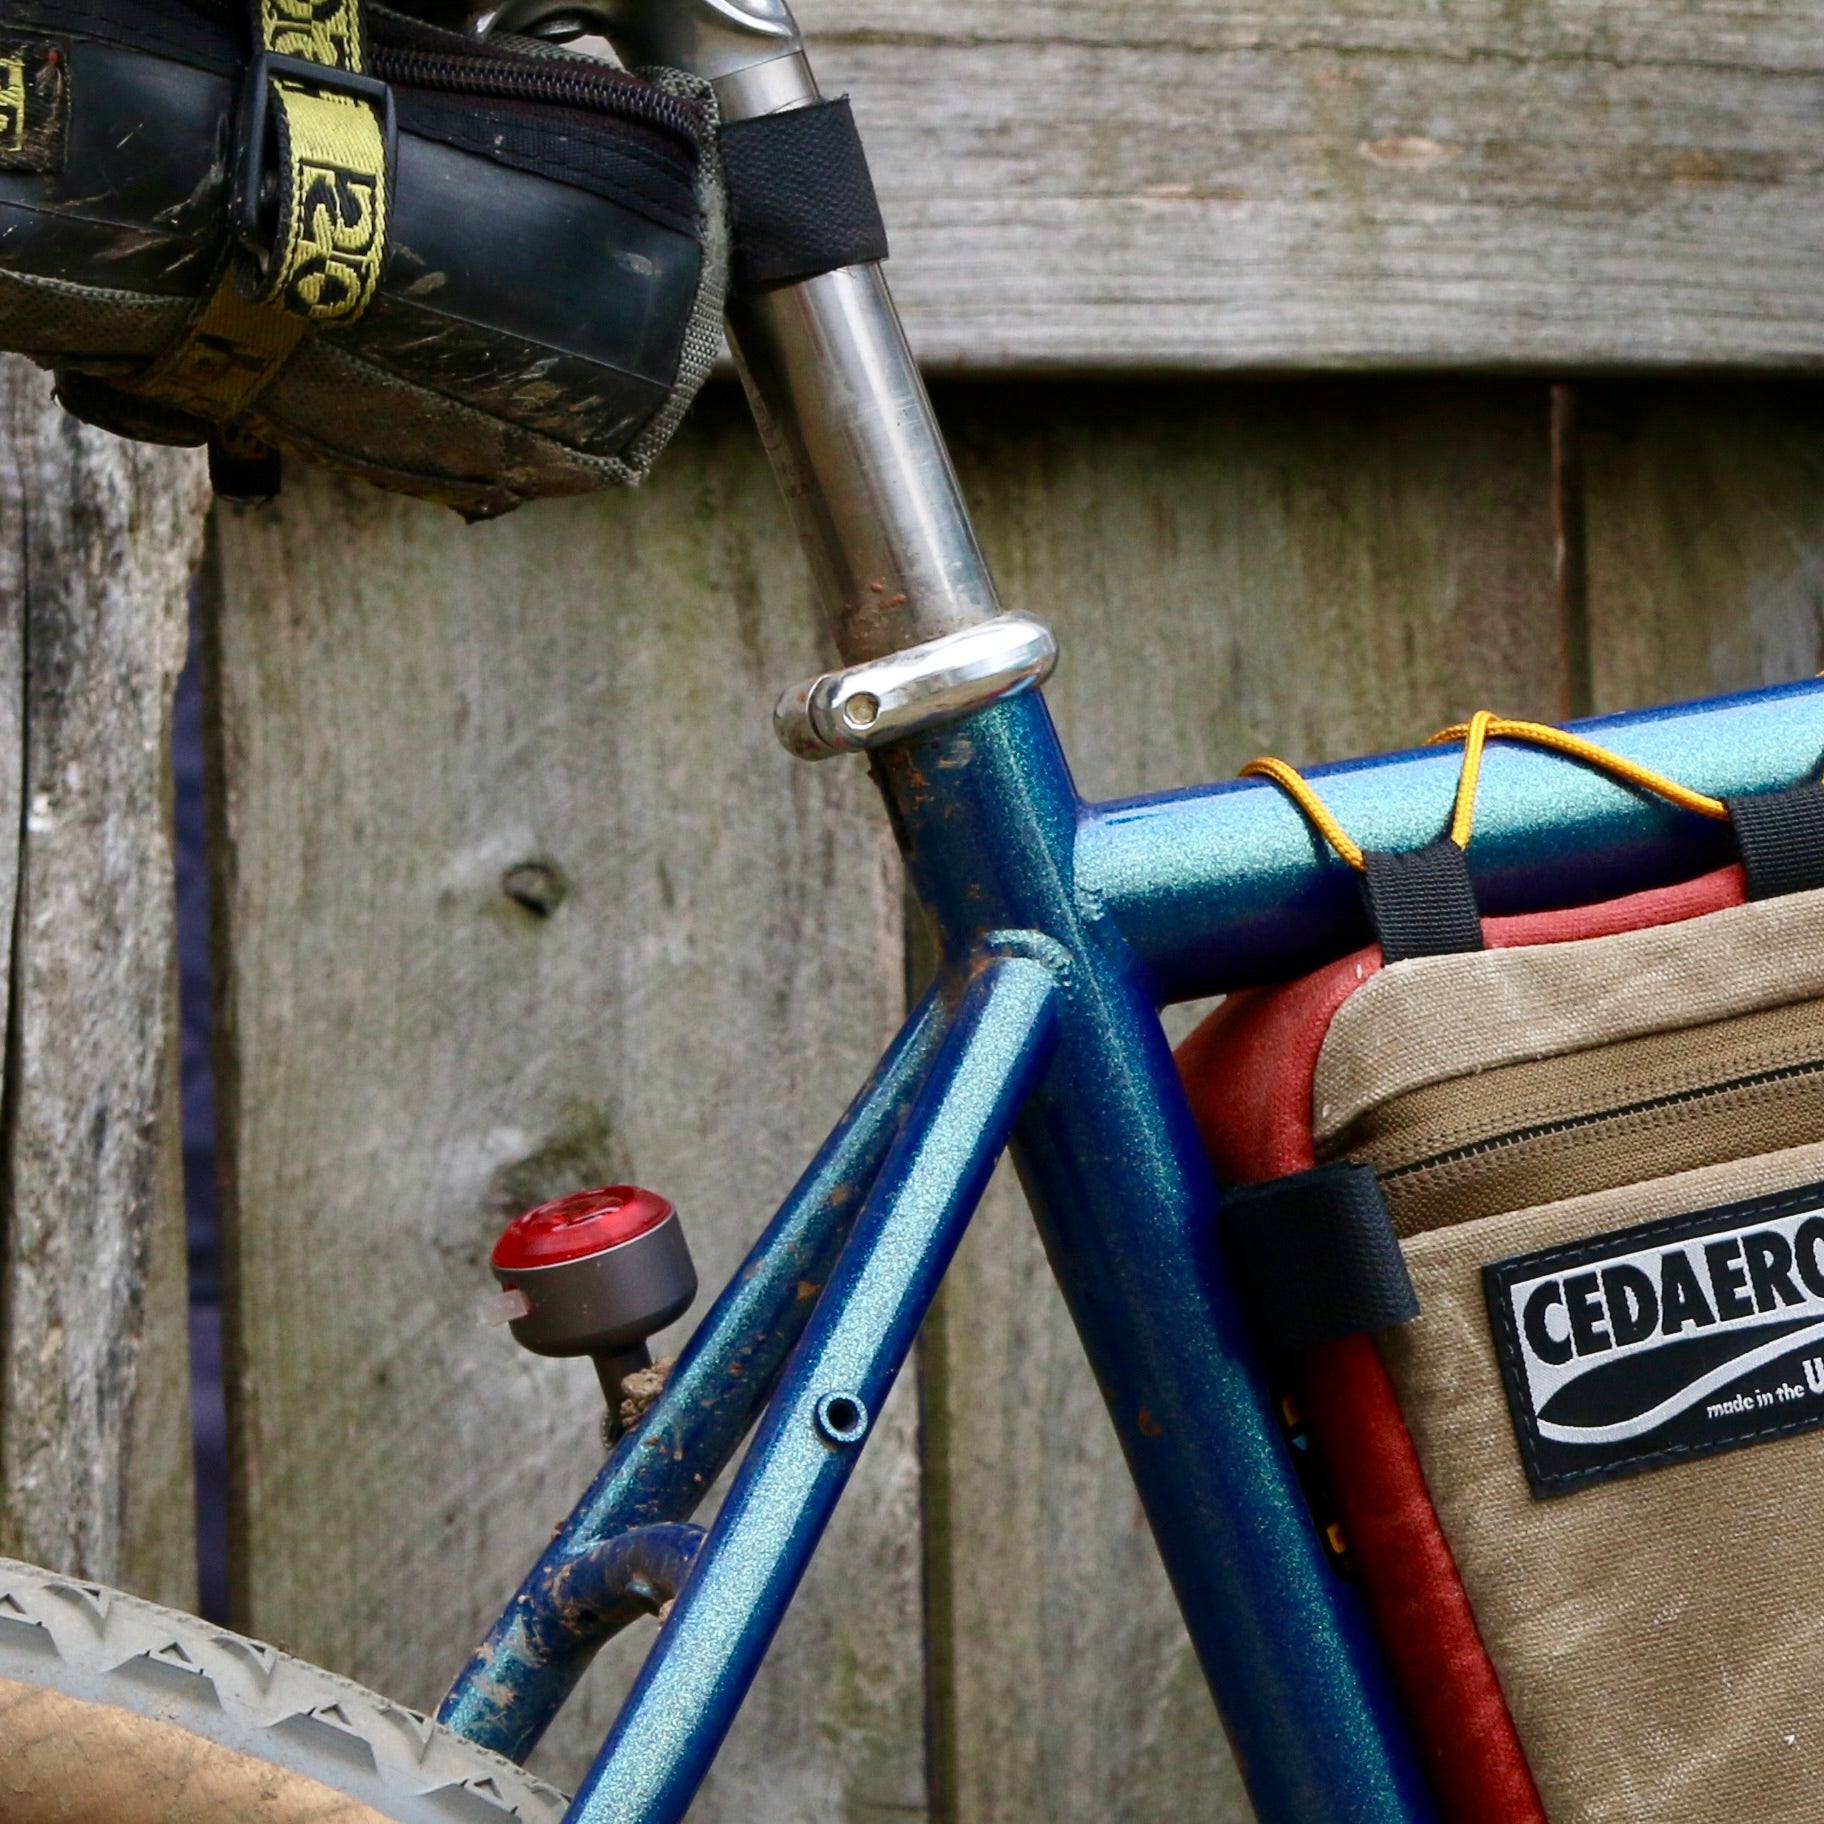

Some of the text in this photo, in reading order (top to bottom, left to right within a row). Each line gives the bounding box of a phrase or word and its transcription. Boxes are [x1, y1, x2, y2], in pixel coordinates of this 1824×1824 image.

[1706, 1394, 1754, 1419] made
[1755, 1389, 1774, 1408] in
[1775, 1383, 1805, 1402] the
